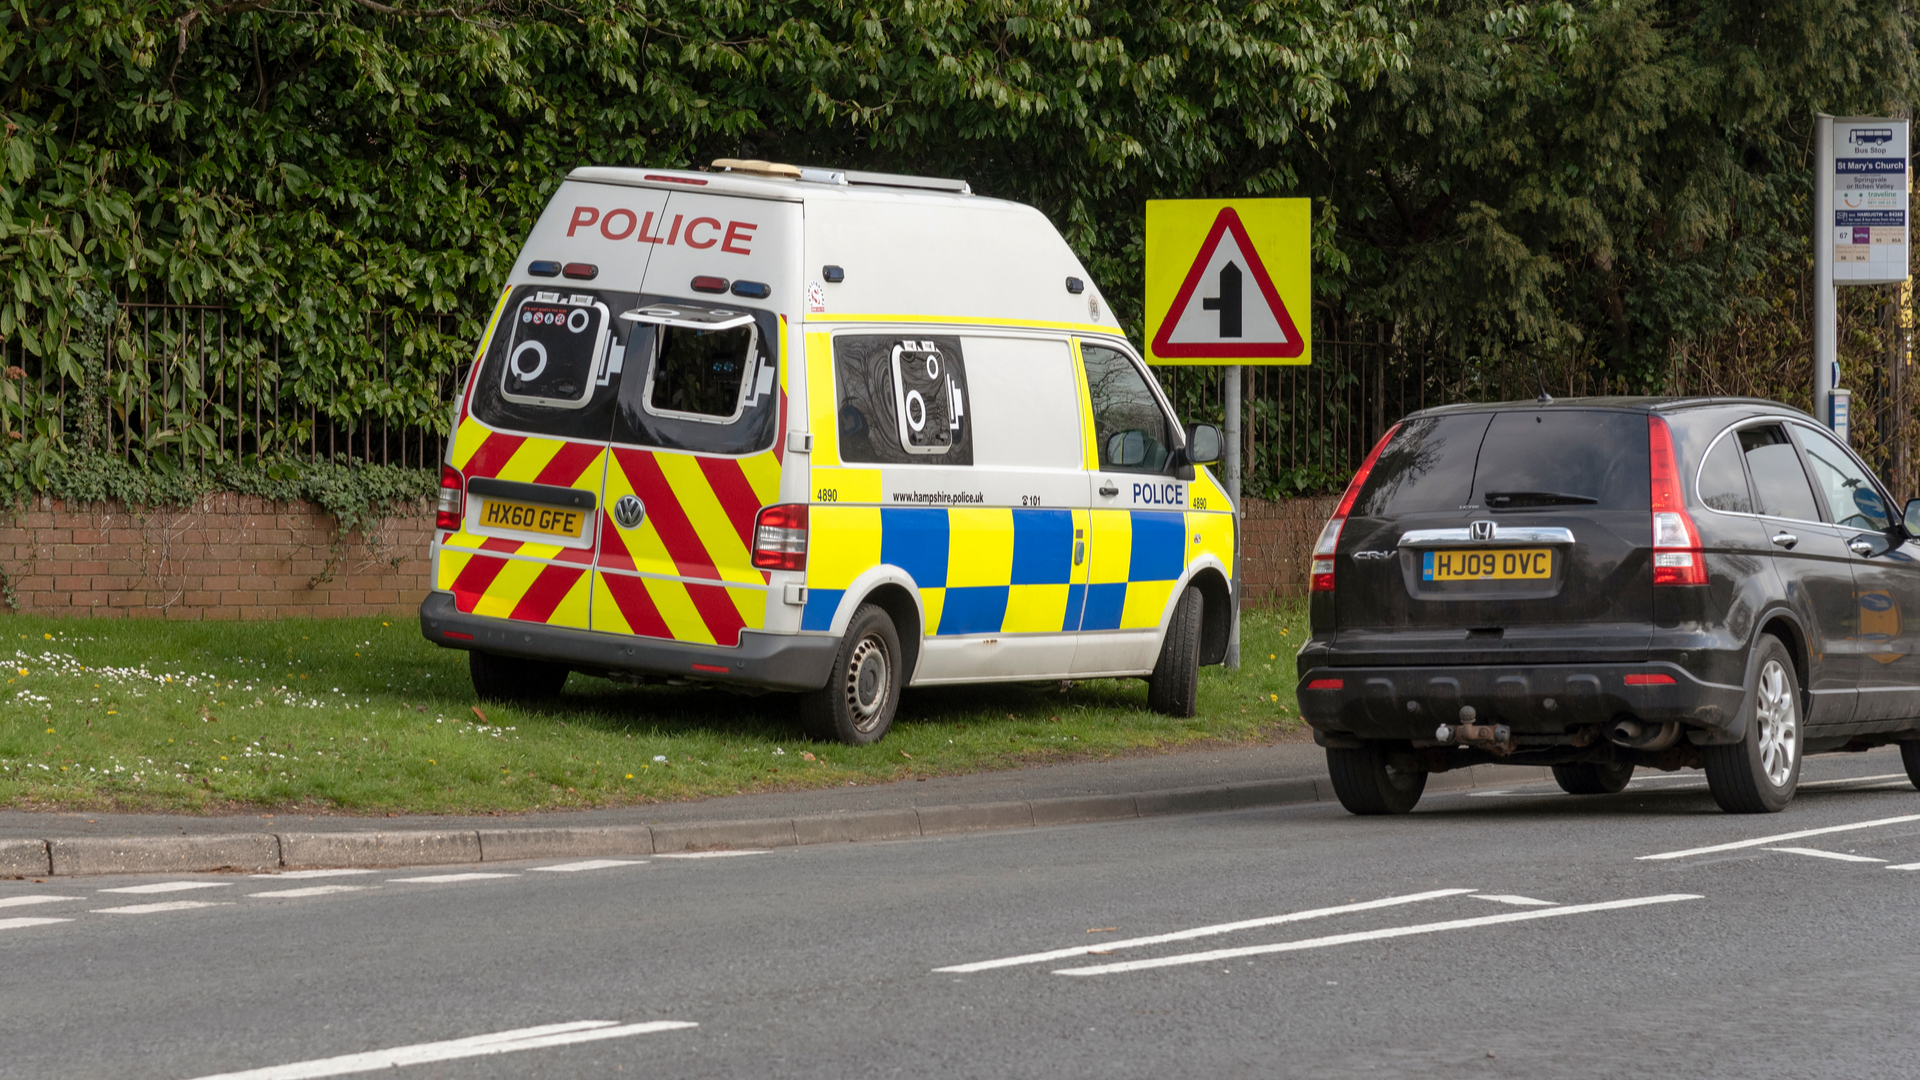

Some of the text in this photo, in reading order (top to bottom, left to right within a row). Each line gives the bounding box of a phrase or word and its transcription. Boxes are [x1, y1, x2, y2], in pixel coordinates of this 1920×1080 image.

[1870, 147, 1886, 155] Stop
[1847, 162, 1873, 171] Mary's
[566, 206, 758, 256] POLICE
[817, 489, 838, 502] 4890
[893, 491, 984, 504] www.hampshire.police.uk
[1133, 483, 1184, 505] POLICE
[1030, 496, 1041, 506] 101
[1193, 497, 1207, 510] 4890
[487, 503, 577, 533] HX60 GFE
[1353, 550, 1397, 560] CR-V
[1437, 553, 1547, 577] HJ09 OVC
